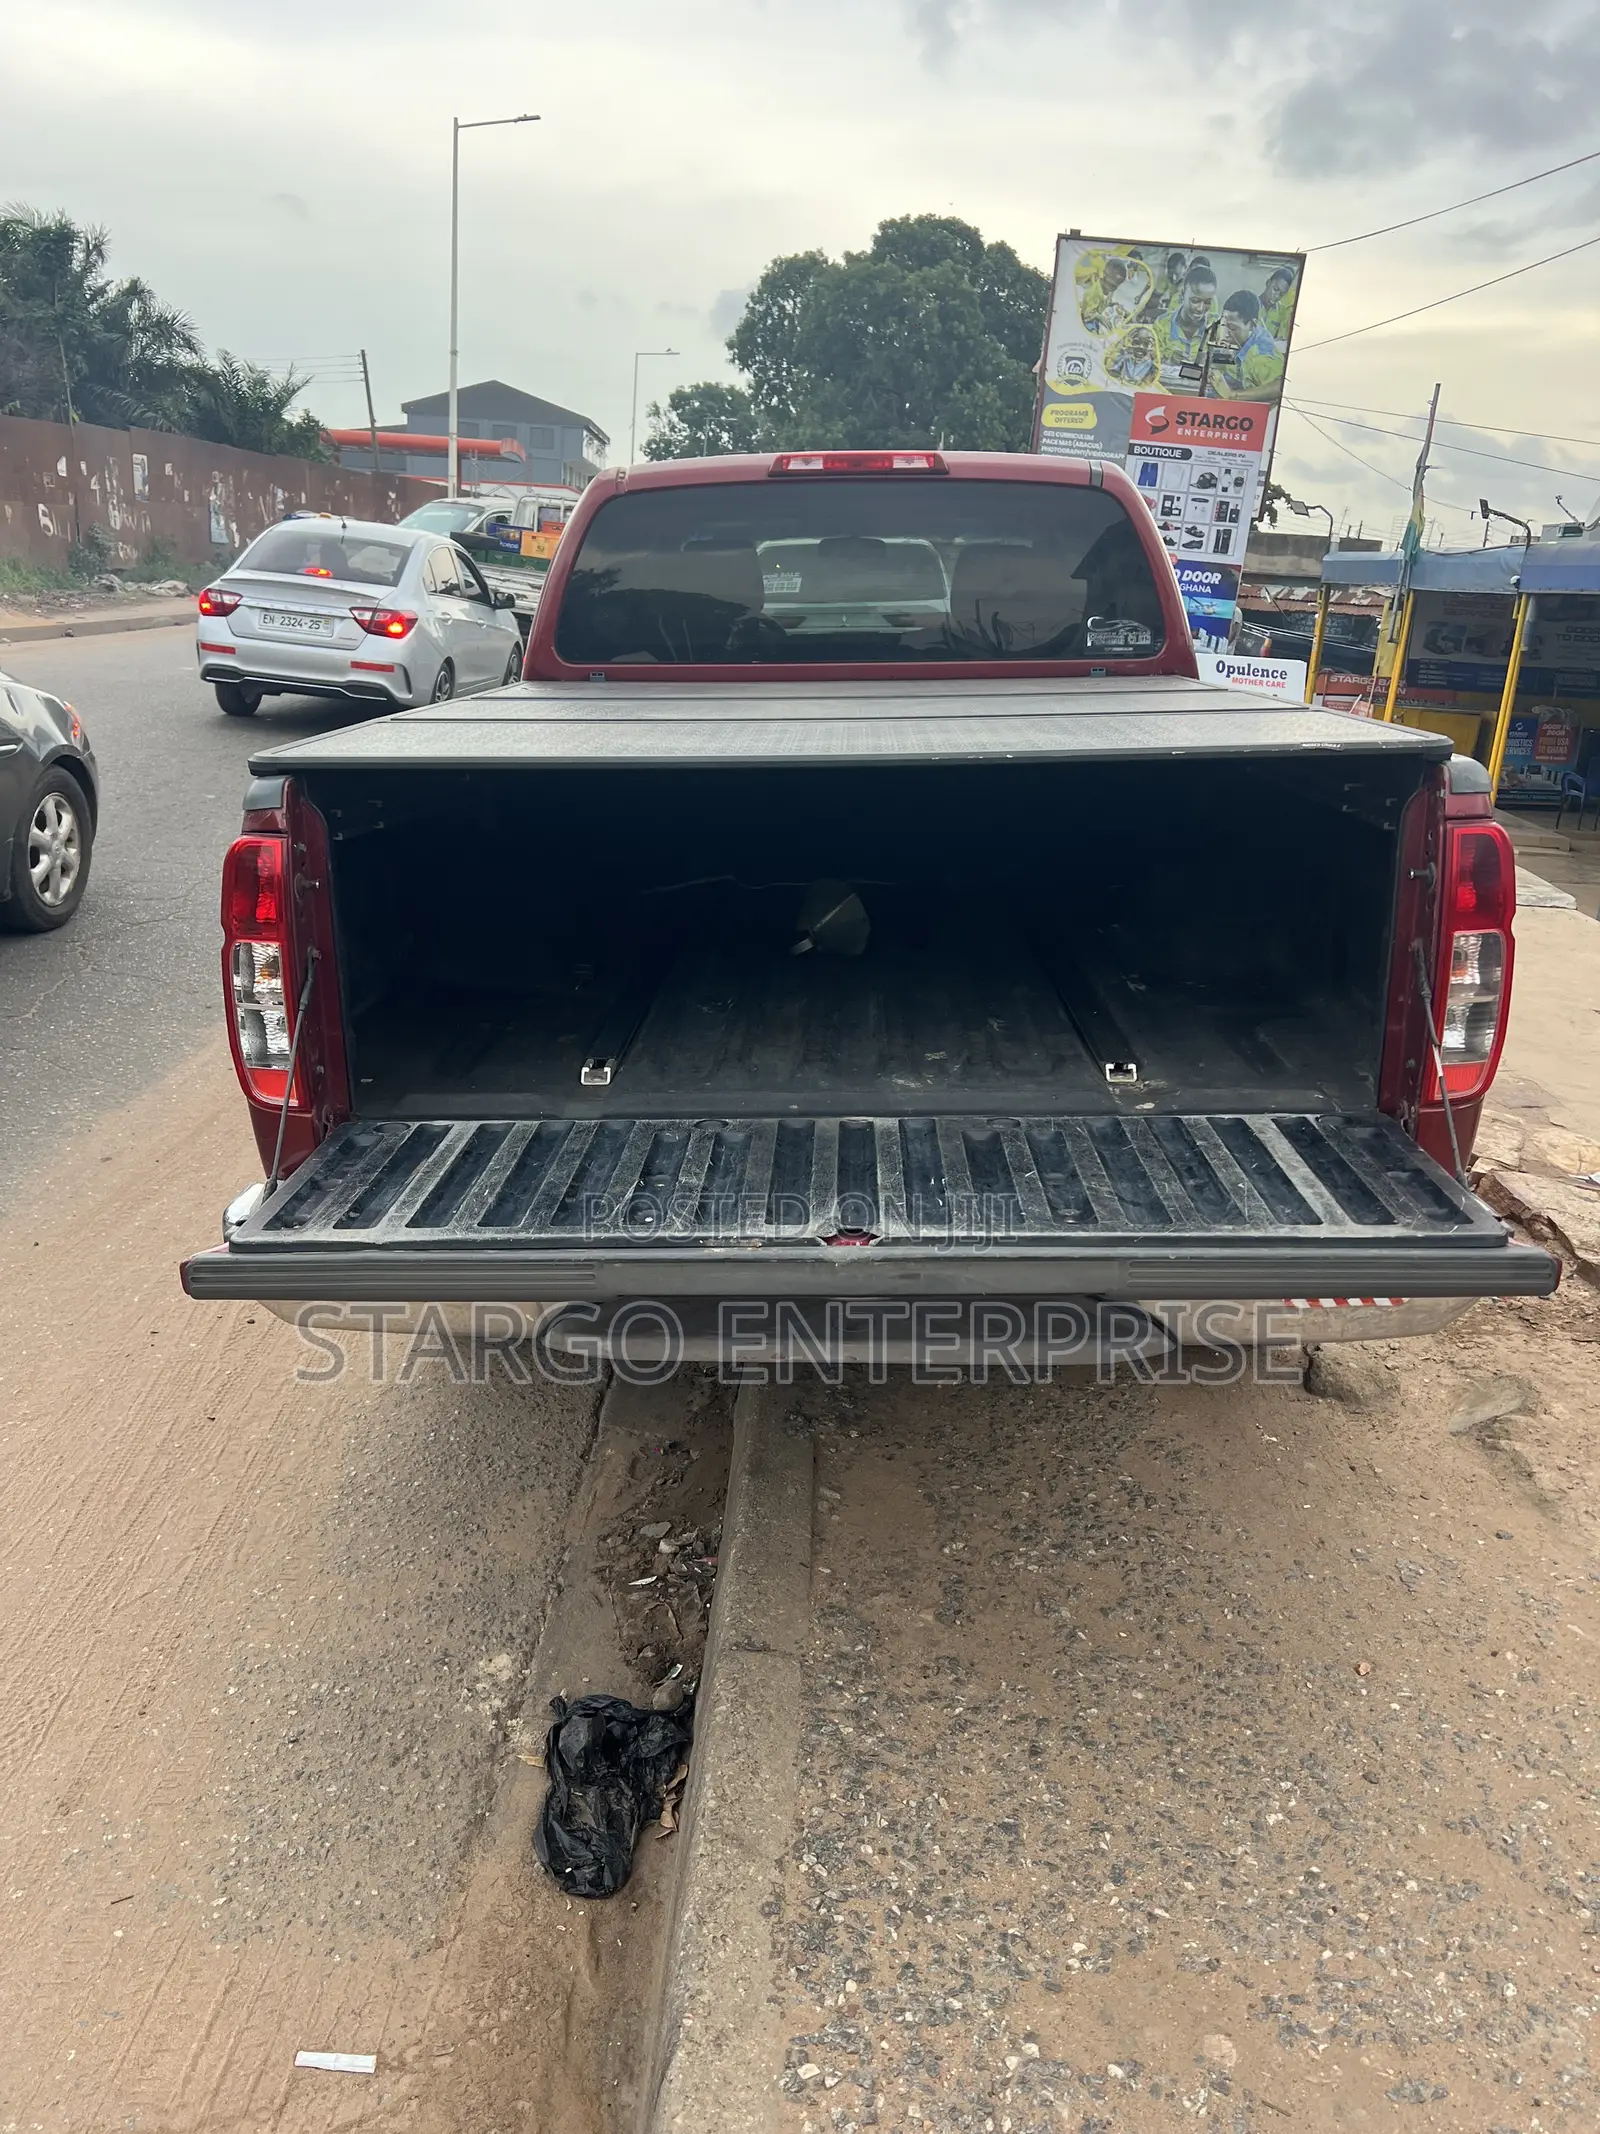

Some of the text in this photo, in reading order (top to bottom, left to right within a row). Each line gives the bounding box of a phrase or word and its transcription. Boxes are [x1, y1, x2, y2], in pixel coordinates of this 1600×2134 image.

[1175, 411, 1254, 432] STARGO
[1055, 432, 1095, 440] CURRICULUM
[1177, 428, 1248, 441] ENTERPRISE
[1072, 440, 1103, 450] (ABACUS)
[1133, 445, 1183, 458] BOUTIQUE
[1181, 569, 1222, 585] DOOR
[1179, 583, 1212, 594] GHANA
[263, 614, 322, 630] EN 2324-25
[1216, 660, 1288, 680] Opulence
[1231, 677, 1287, 689] MOTHER CARE
[1330, 675, 1375, 685] STARGO
[1366, 685, 1406, 695] SALN
[1557, 737, 1569, 746] USA
[1505, 746, 1532, 755] ERVICES
[1546, 746, 1568, 754] GHANA
